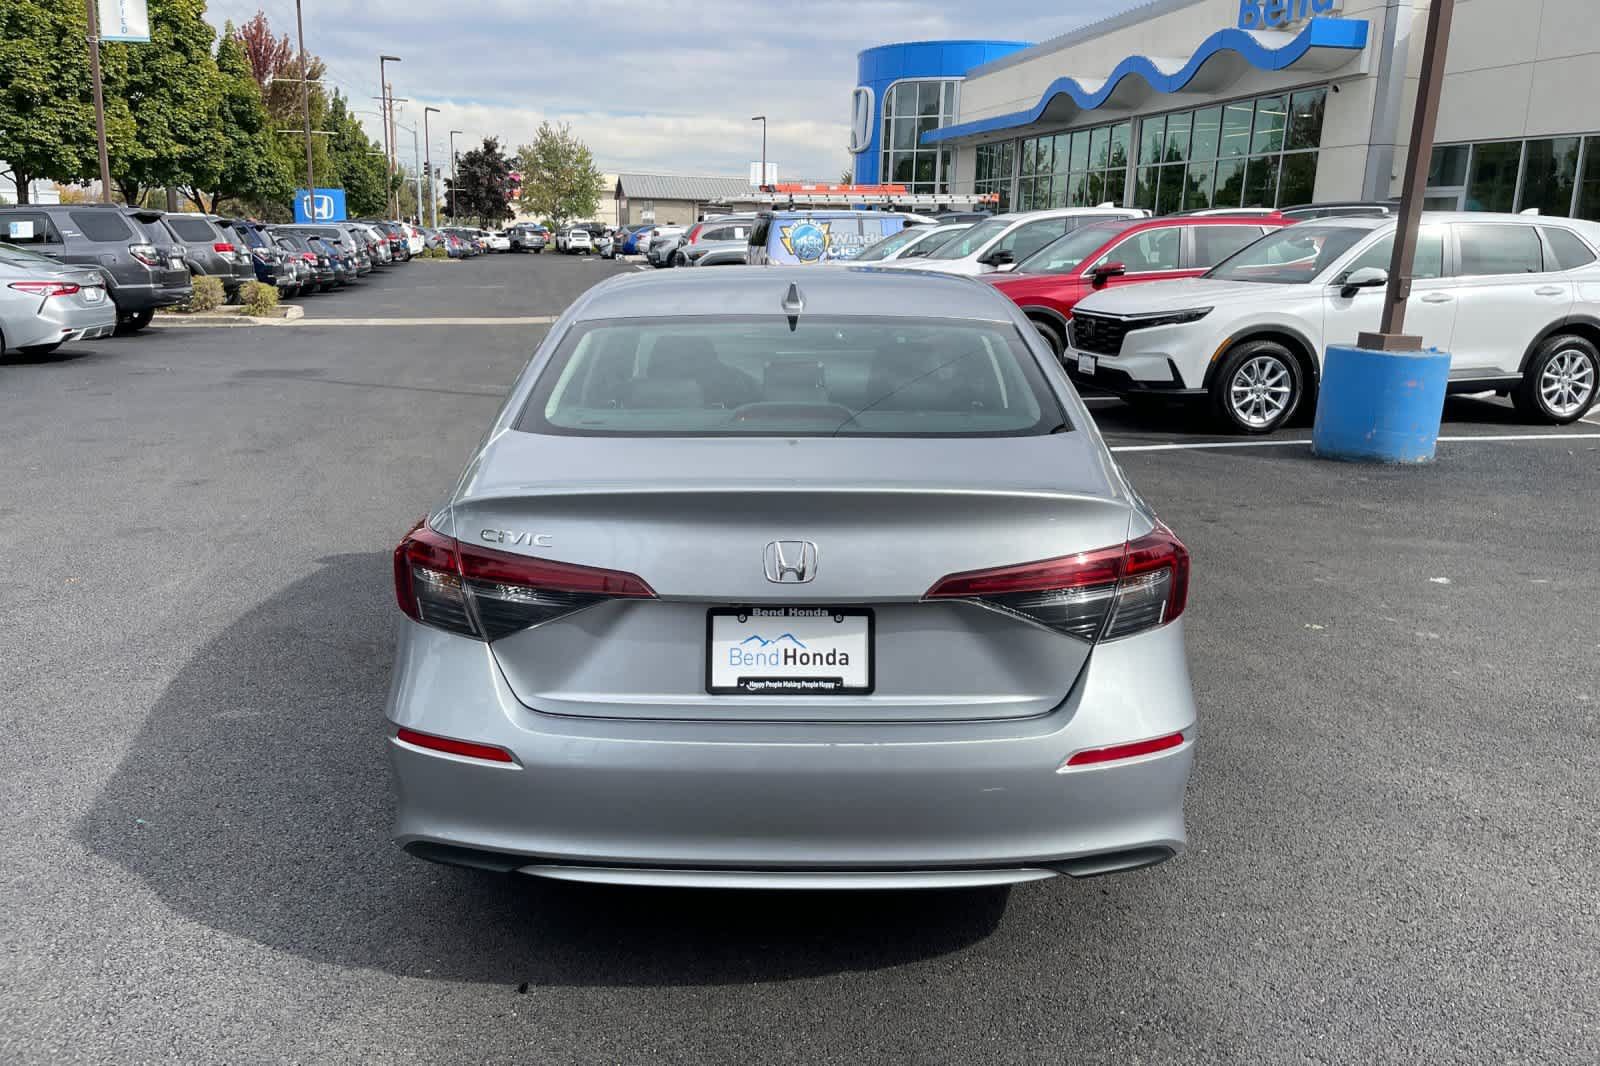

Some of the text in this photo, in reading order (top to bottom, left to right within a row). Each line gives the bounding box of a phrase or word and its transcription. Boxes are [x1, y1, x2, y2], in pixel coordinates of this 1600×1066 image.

[480, 528, 553, 548] CIVIC
[752, 608, 829, 617] Bend Honda
[749, 680, 835, 689] Happy People Making People Happy
